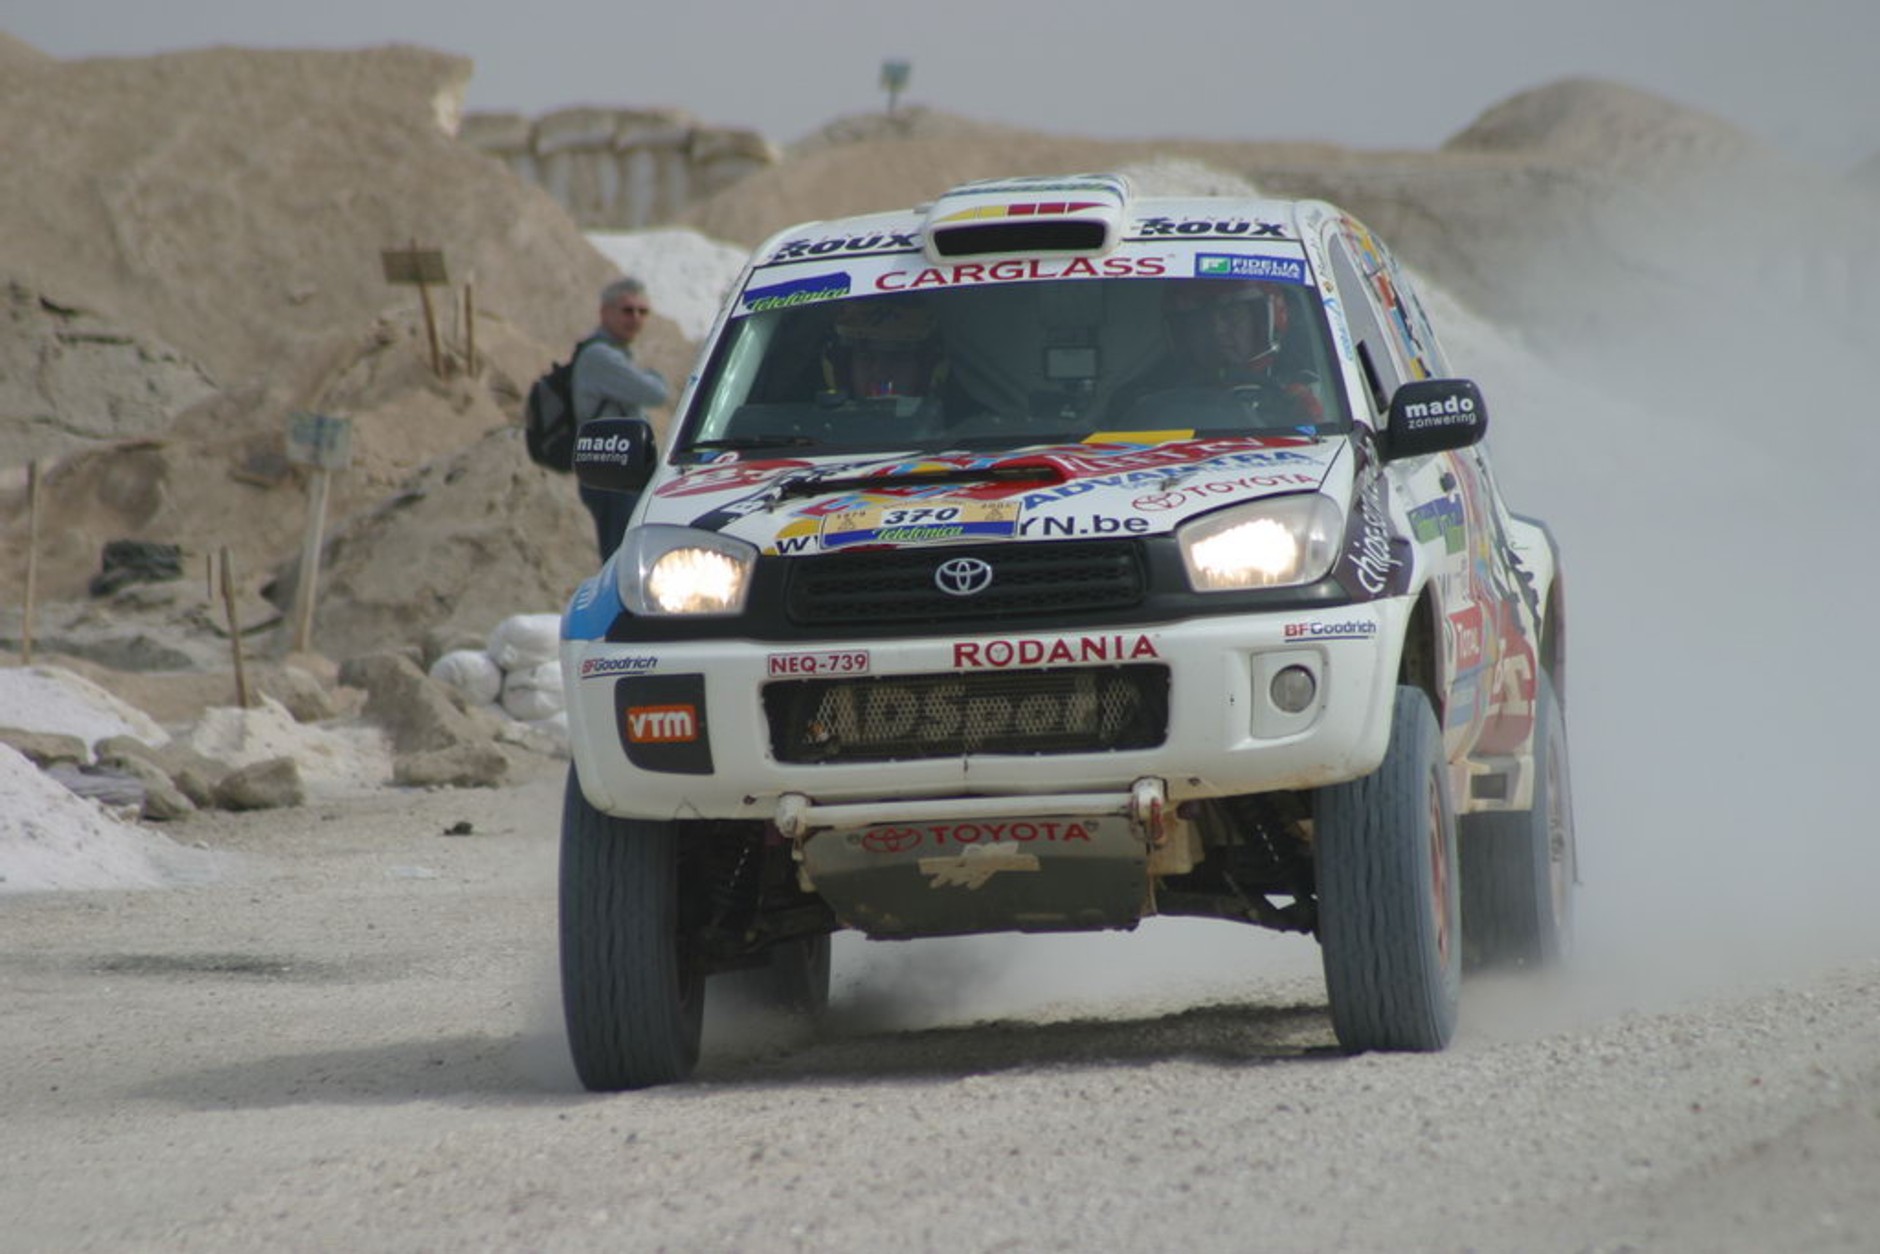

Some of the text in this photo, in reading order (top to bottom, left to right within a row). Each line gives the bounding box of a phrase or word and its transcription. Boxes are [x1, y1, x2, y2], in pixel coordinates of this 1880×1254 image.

[875, 256, 1166, 290] CARGLASS
[1232, 257, 1300, 273] FIDELIA
[1232, 266, 1300, 280] ASSISTANCE
[1405, 395, 1474, 418] mado
[1408, 411, 1476, 430] zonwering
[577, 435, 631, 453] mado
[1183, 473, 1320, 498] TOYOTA
[884, 506, 959, 526] 370
[1284, 619, 1377, 638] BFGoodrich
[953, 634, 1159, 668] RODANIA
[581, 656, 658, 674] BFGoodrich
[770, 653, 867, 674] NEQ-739
[927, 820, 1091, 845] TOYOTA
